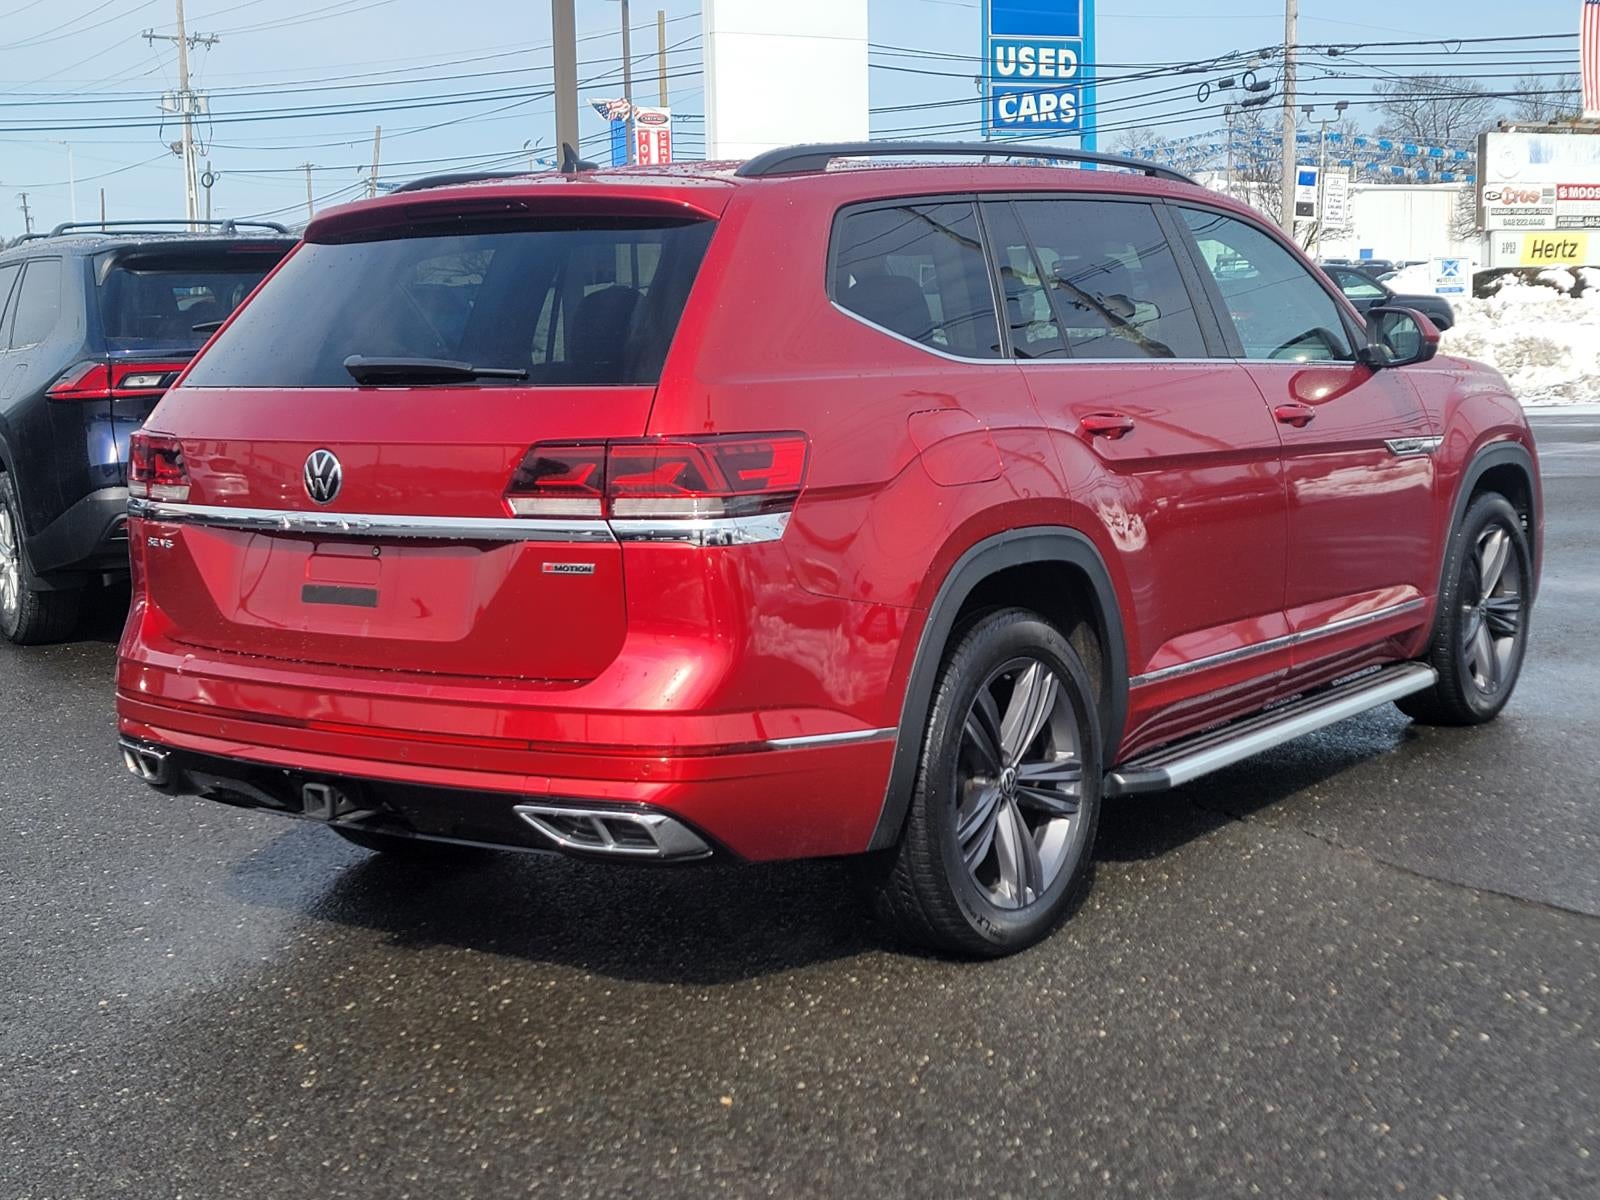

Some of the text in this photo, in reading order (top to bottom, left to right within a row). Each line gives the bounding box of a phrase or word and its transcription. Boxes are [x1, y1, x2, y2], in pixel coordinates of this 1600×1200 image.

[996, 46, 1077, 78] USED
[998, 92, 1077, 123] CARS
[1530, 239, 1578, 258] Hertz
